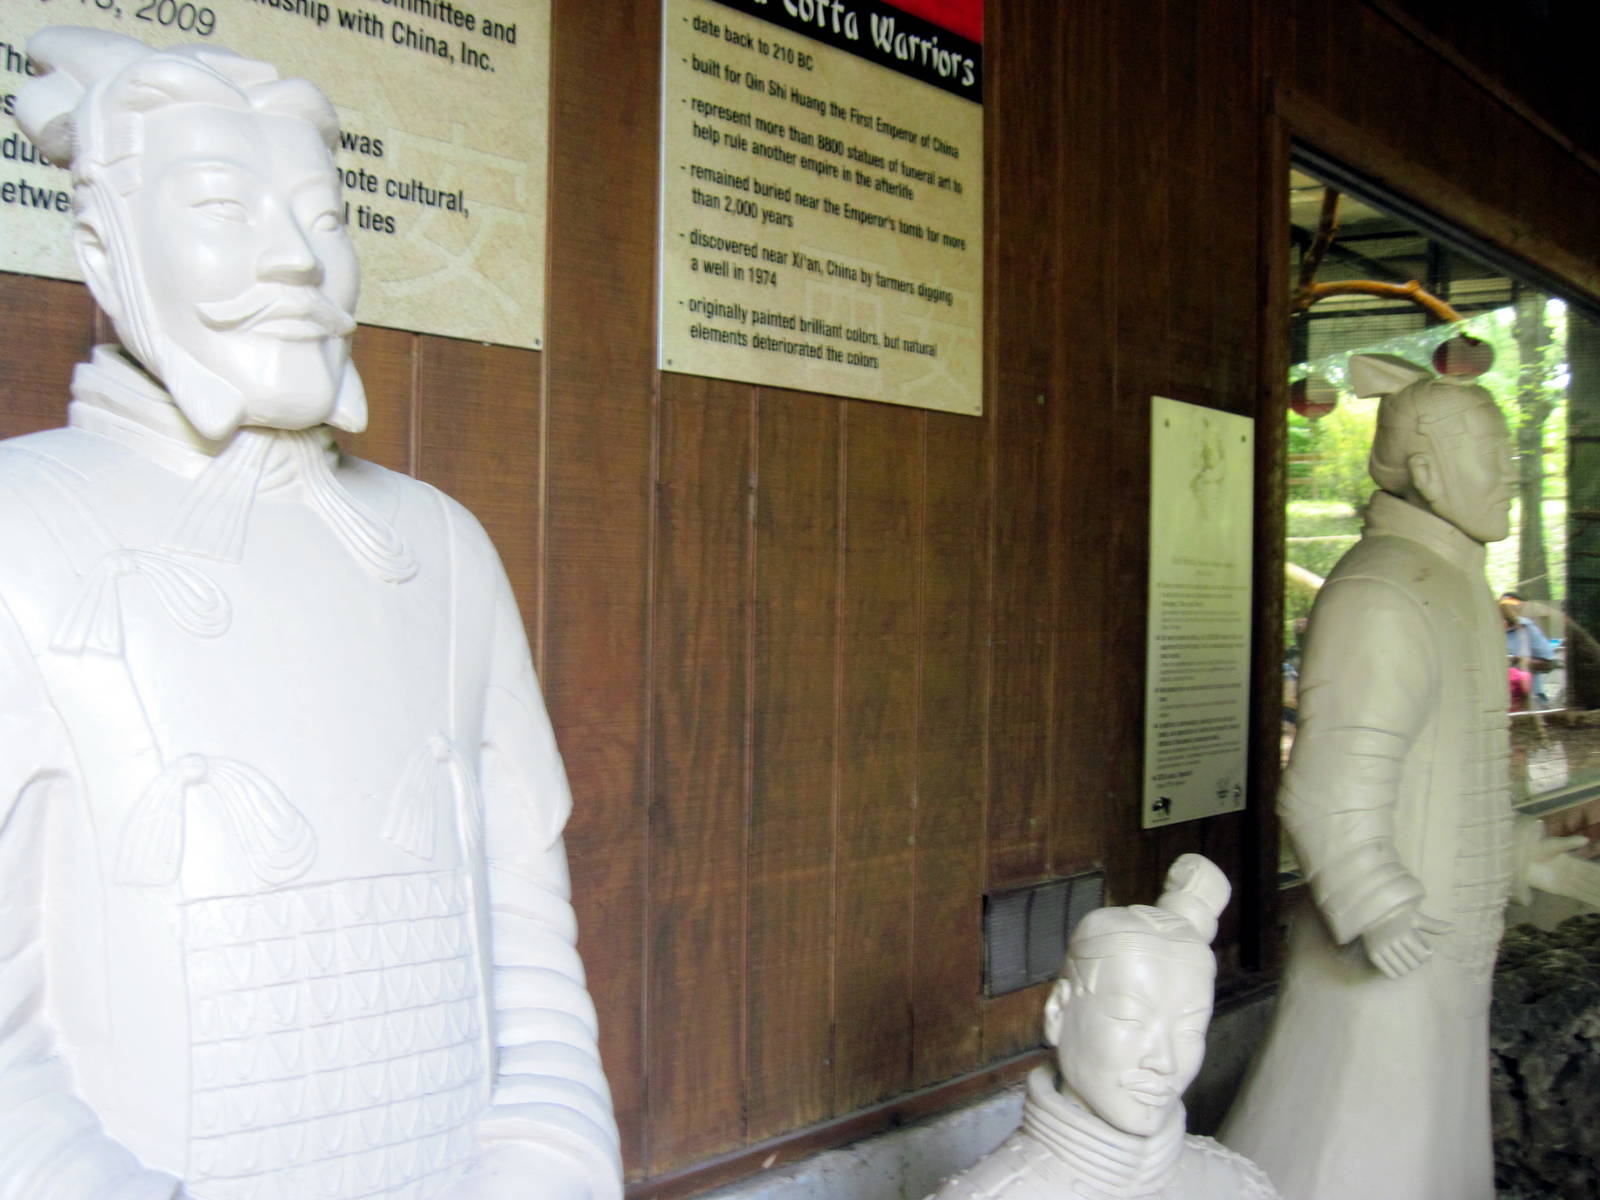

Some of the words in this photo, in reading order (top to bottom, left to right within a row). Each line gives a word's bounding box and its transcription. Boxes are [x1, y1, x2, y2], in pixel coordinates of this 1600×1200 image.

[135, 0, 216, 35] 2009
[337, 8, 384, 39] with
[391, 20, 454, 64] China,
[460, 42, 495, 72] Inc.
[381, 0, 476, 30] mmittee
[482, 19, 517, 44] and
[692, 14, 721, 38] date
[724, 24, 754, 50] back
[757, 36, 770, 56] to
[772, 42, 795, 64] 210
[797, 50, 814, 72] BC
[870, 12, 976, 87] Warriors
[692, 53, 721, 78] built
[724, 64, 741, 84] for
[745, 72, 766, 93] Qin
[768, 79, 788, 100] Shi
[790, 87, 827, 116] Huang
[829, 101, 847, 121] the
[849, 107, 873, 129] First
[875, 116, 918, 144] Emperor
[920, 134, 931, 149] of
[932, 136, 960, 159] China
[339, 129, 384, 157] was
[690, 98, 752, 129] represent
[755, 117, 786, 138] more
[787, 124, 816, 146] than
[816, 133, 845, 156] 8800
[846, 145, 886, 169] statues
[888, 158, 900, 174] of
[900, 160, 937, 185] funeral
[937, 175, 952, 191] art
[952, 178, 964, 195] to
[692, 120, 720, 146] help
[723, 132, 749, 152] rule
[751, 141, 797, 166] another
[799, 156, 840, 178] empire
[841, 165, 853, 182] in
[855, 169, 873, 188] the
[874, 177, 915, 200] afterlife
[357, 204, 397, 234] ties
[385, 178, 470, 219] cultural,
[690, 164, 751, 192] remained
[753, 177, 793, 203] buried
[794, 191, 821, 211] near
[822, 197, 842, 217] the
[842, 202, 897, 232] Emperor's
[898, 218, 925, 240] tomb
[925, 226, 940, 243] for
[942, 234, 967, 251] more
[690, 187, 722, 210] than
[723, 195, 759, 218] 2,000
[760, 207, 795, 228] years
[689, 228, 759, 258] discovered
[761, 247, 789, 265] near
[826, 259, 858, 281] China
[859, 267, 873, 288] by
[874, 271, 916, 295] farmers
[917, 282, 954, 307] digging
[690, 256, 700, 272] a
[703, 259, 730, 278] well
[732, 262, 745, 281] in
[748, 266, 778, 287] 1974
[688, 297, 749, 324] originally
[750, 308, 797, 331] painted
[799, 315, 843, 338] brilliant
[882, 332, 901, 349] but
[902, 338, 939, 357] natural
[689, 322, 749, 347] elements
[751, 332, 824, 360] deteriorated
[825, 345, 845, 363] the
[846, 351, 881, 370] colors
